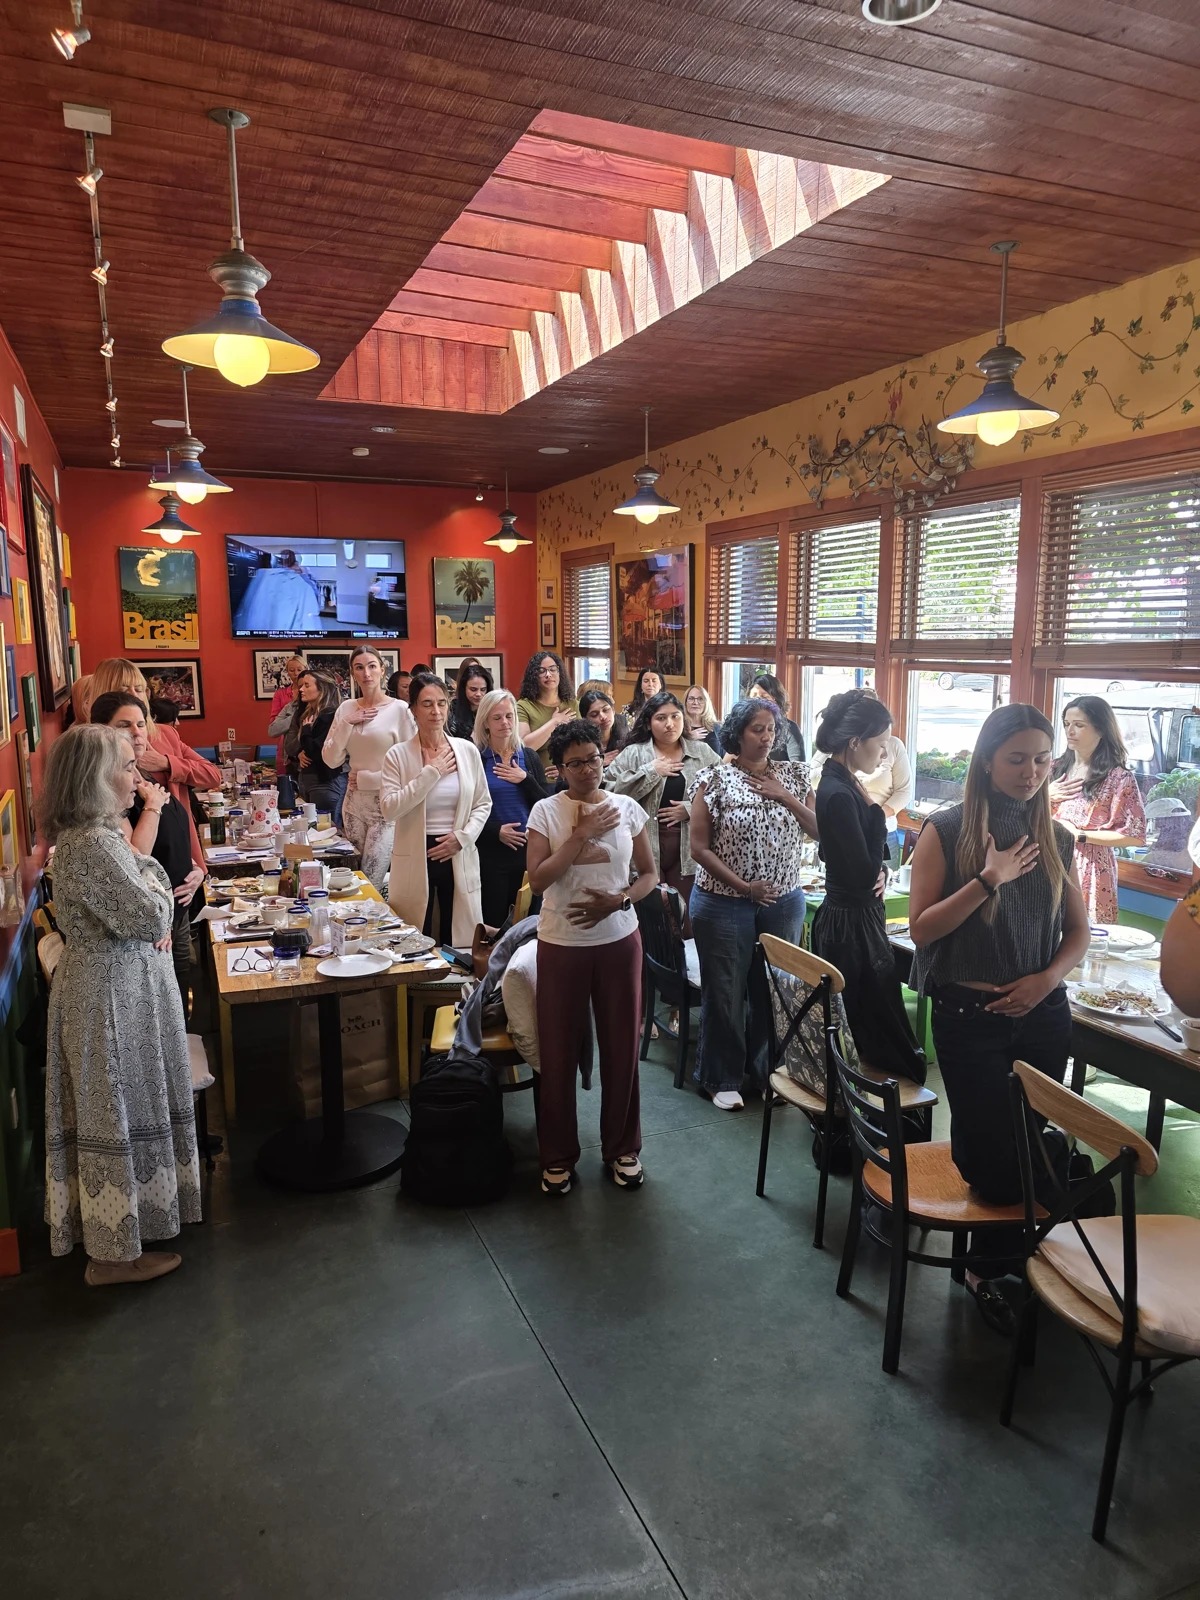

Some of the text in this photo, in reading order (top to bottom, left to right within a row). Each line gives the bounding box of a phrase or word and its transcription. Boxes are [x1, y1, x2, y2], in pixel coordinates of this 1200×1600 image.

[123, 611, 198, 640] Brasil
[436, 615, 495, 640] Brasil
[341, 1019, 381, 1034] OACH
